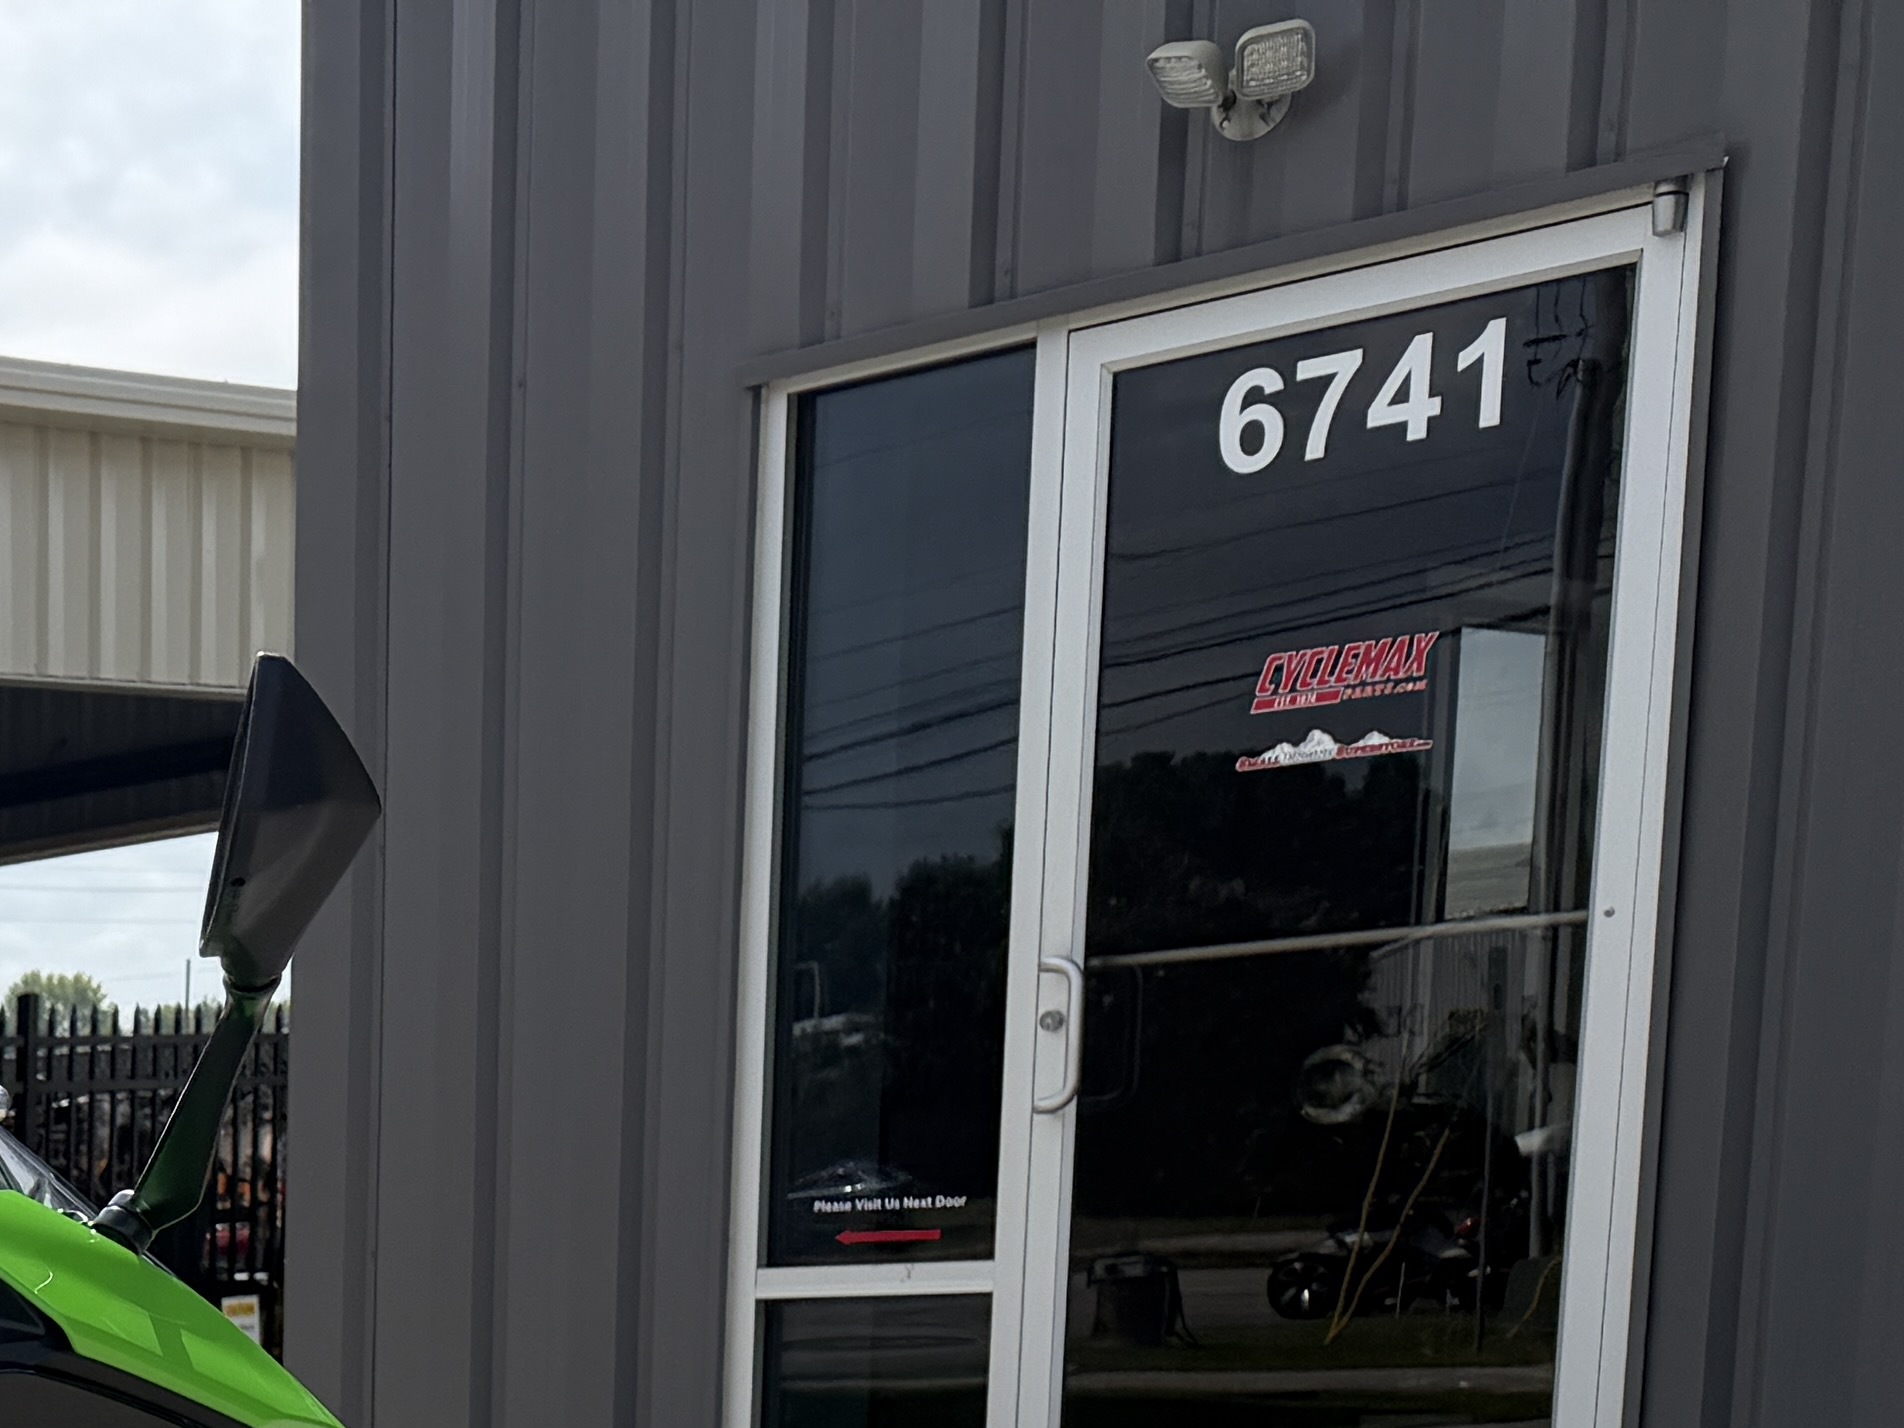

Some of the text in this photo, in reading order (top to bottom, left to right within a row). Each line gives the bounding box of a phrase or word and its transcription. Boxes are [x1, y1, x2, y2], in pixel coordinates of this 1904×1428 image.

[1219, 317, 1507, 475] 6741
[1255, 631, 1440, 696] CYCLEMAX
[813, 1194, 967, 1213] Please Visit Us Next Door
